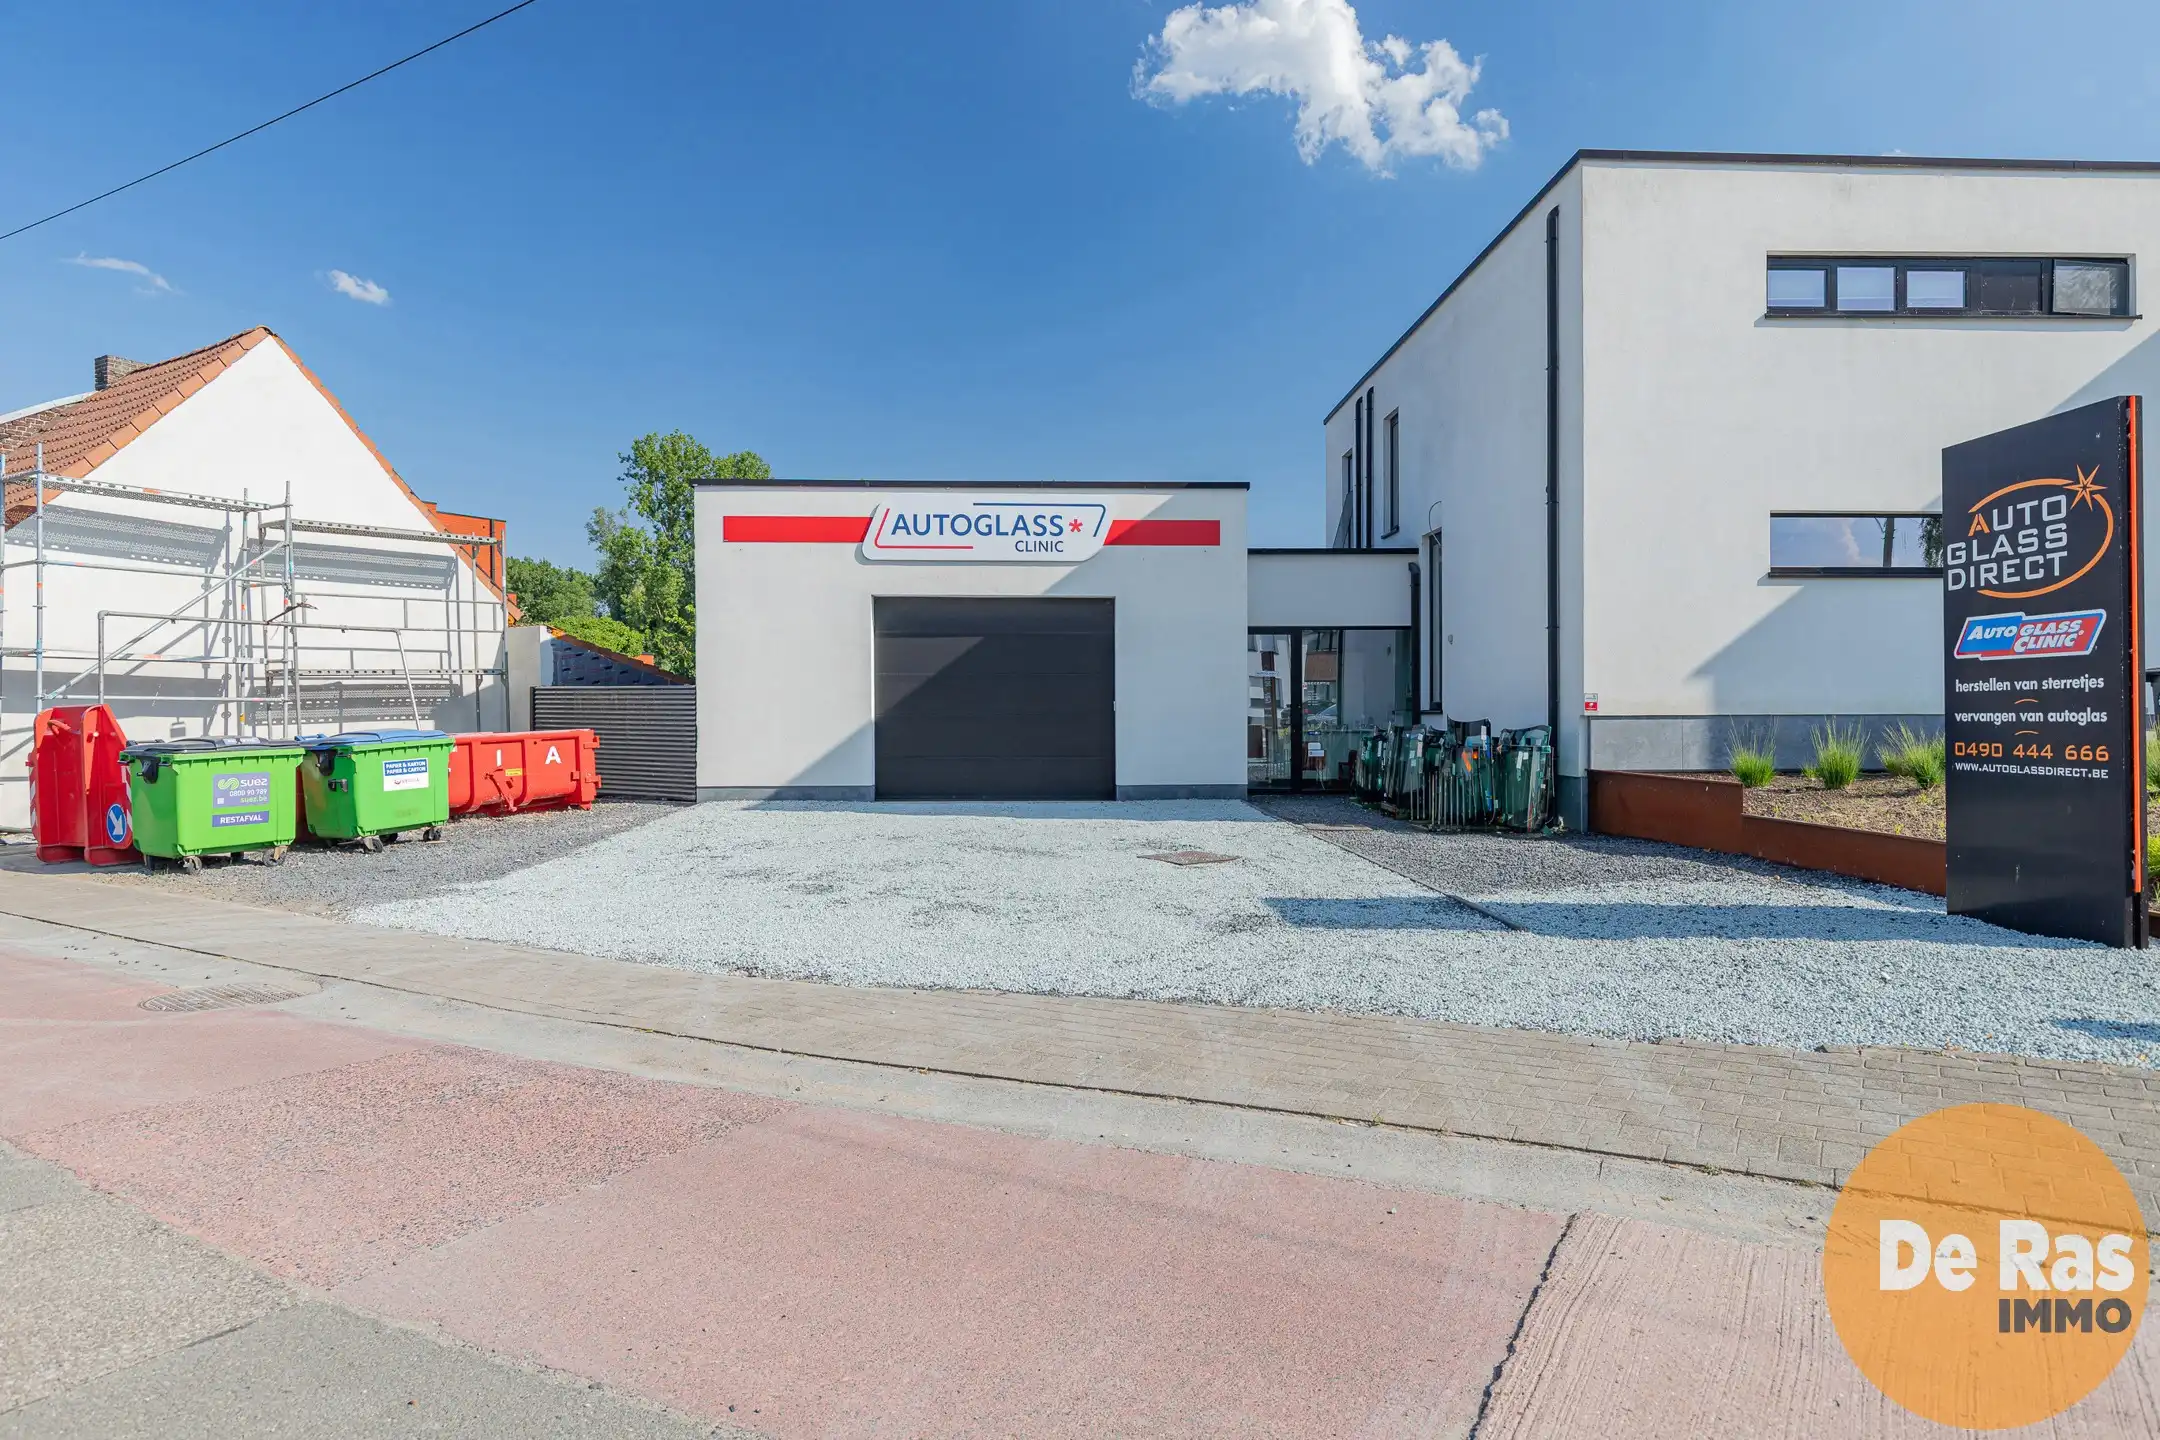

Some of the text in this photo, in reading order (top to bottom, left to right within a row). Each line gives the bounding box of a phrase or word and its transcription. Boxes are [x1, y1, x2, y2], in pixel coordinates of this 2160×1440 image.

[1967, 494, 2067, 537] AUTO
[1015, 540, 1064, 553] CLINIC
[1946, 522, 2068, 566] GLASS
[1947, 550, 2068, 591] DIRECT
[2013, 633, 2078, 653] CLINIC
[1955, 673, 2105, 693] herstellen van sterretjes
[1954, 707, 2108, 726] vervangen van autoglas
[545, 745, 562, 764] A
[1955, 742, 2109, 761] 0490 444 666
[1955, 762, 2109, 779] WWW.AUTOGLASSDIRECT.BE
[240, 778, 268, 787] suez
[229, 789, 246, 797] 0800
[220, 814, 263, 824] RESTAFVAL
